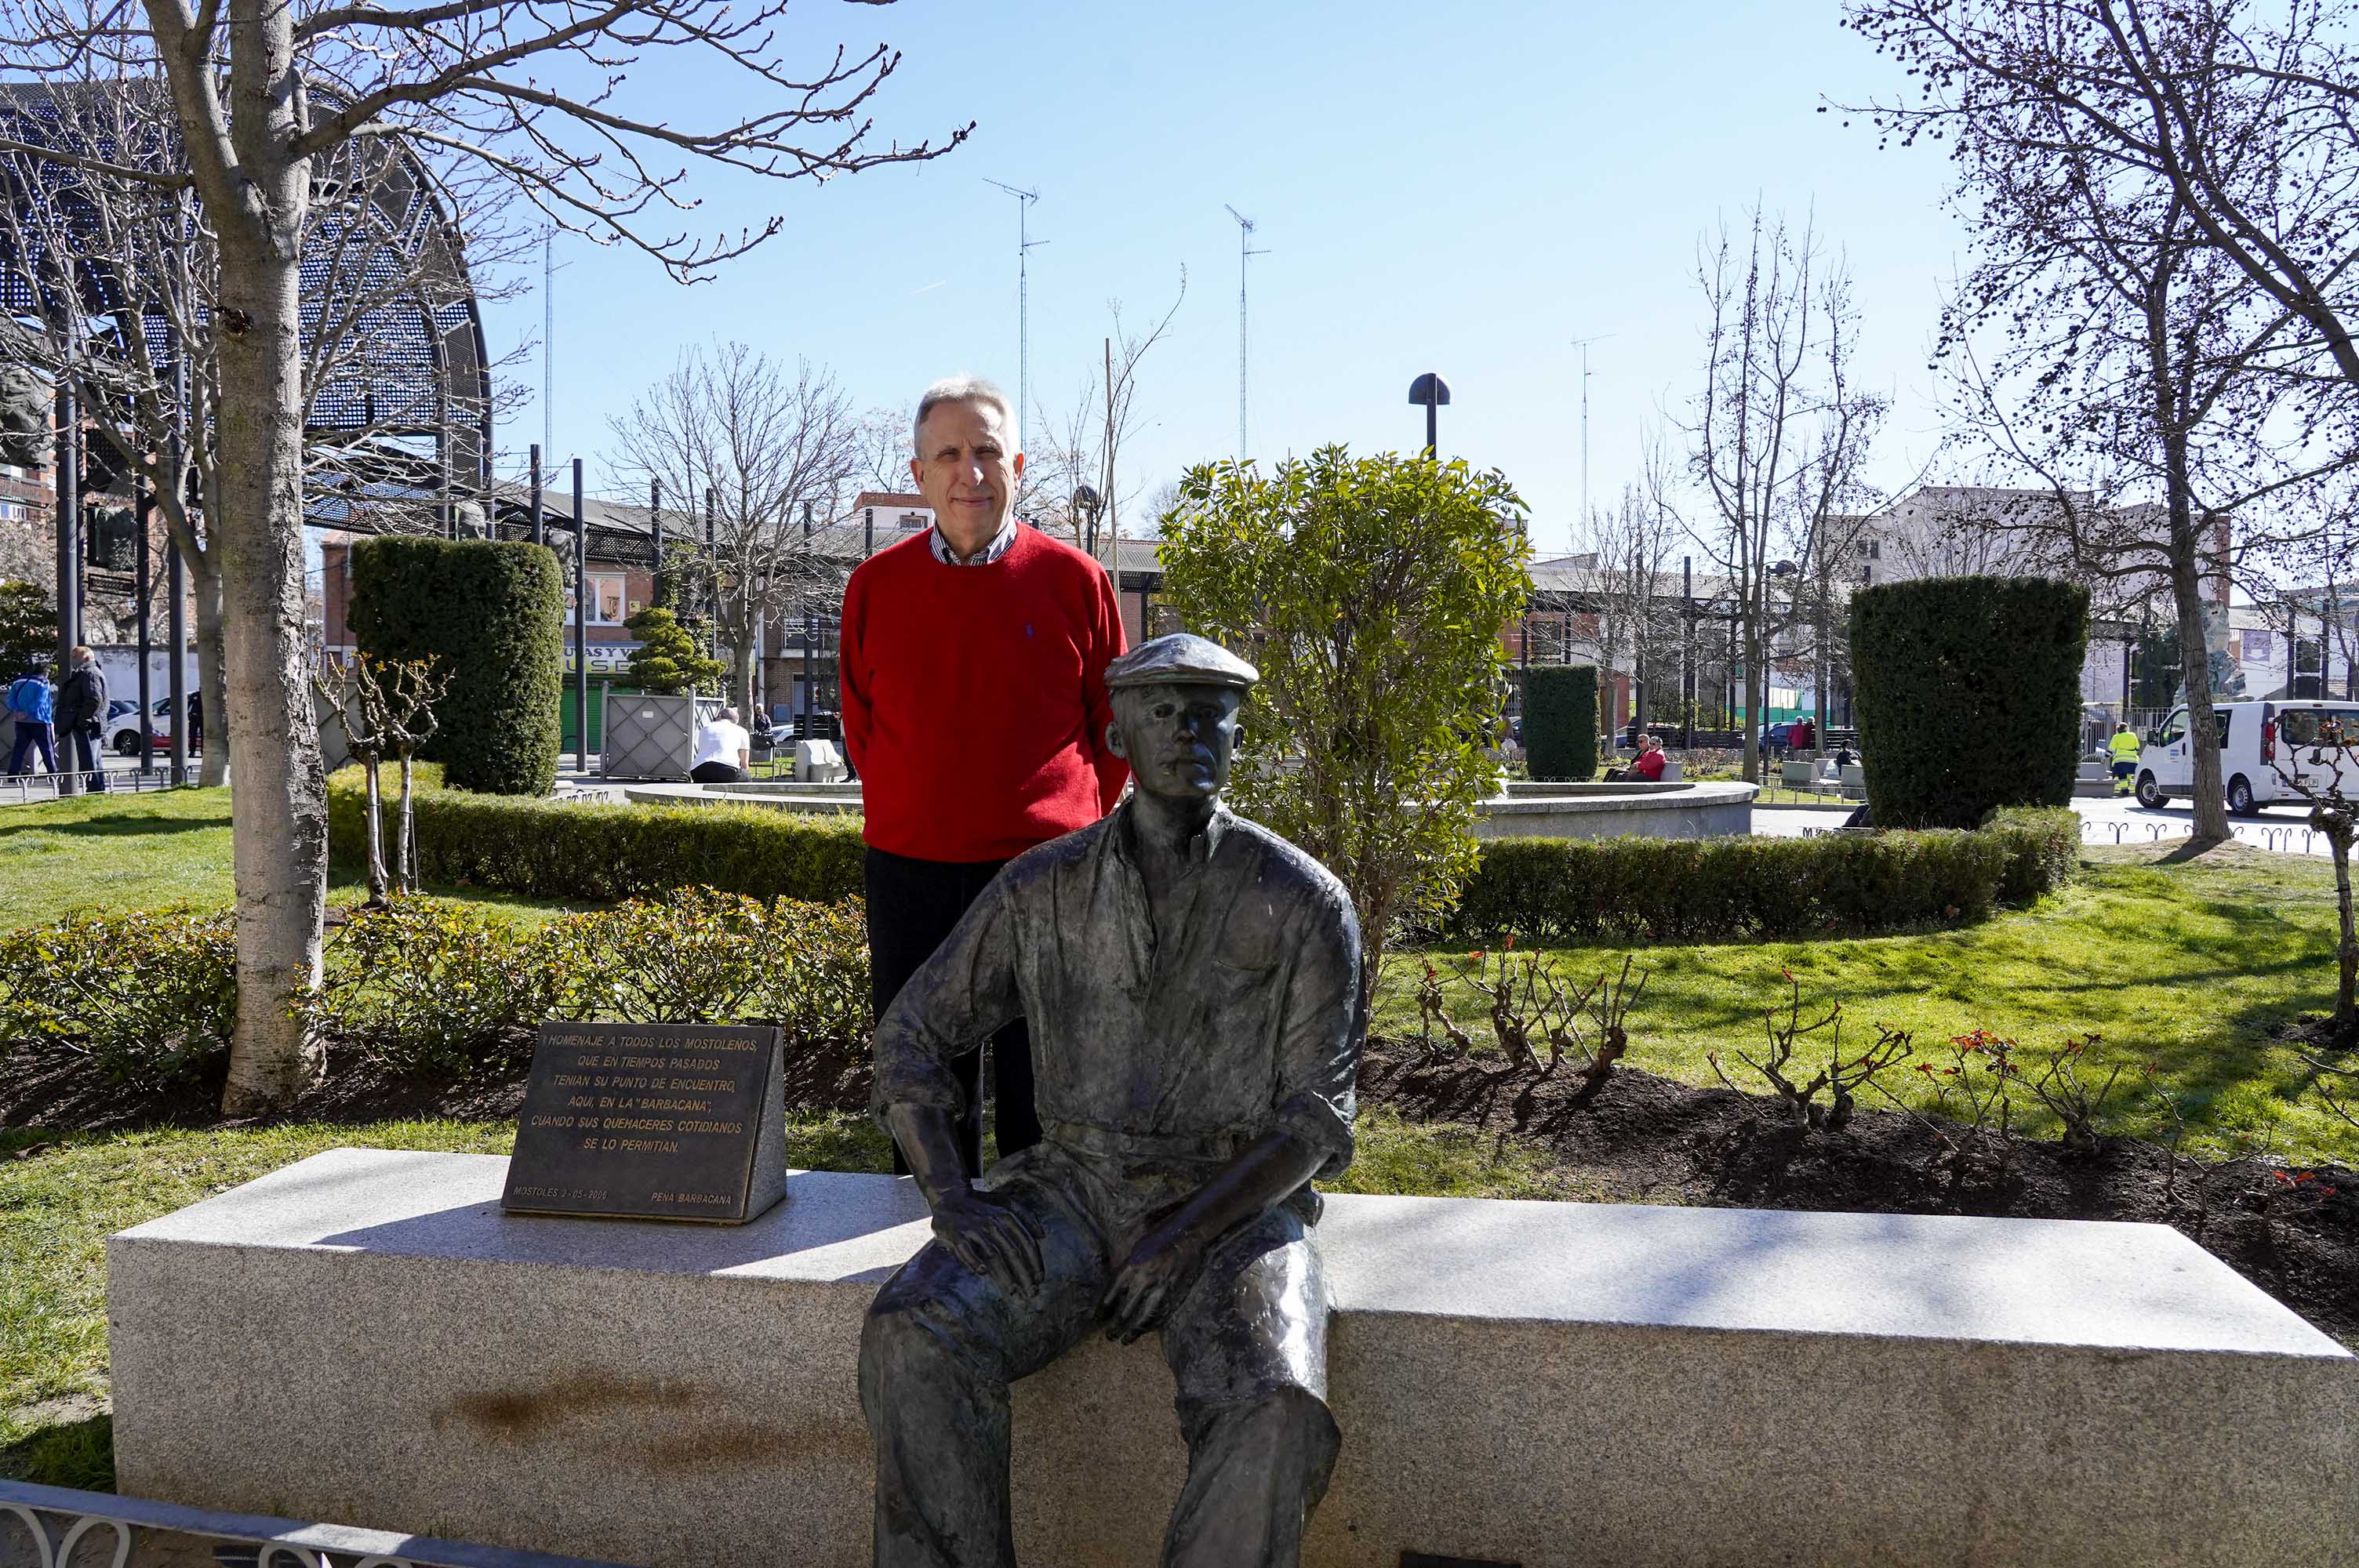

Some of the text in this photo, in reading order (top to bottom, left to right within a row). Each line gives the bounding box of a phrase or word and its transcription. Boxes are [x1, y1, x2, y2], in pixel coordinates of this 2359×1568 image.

[605, 648, 616, 657] Y
[548, 1034, 604, 1047] HOMENAJE
[608, 1036, 616, 1047] A
[620, 1036, 656, 1048] TODOS
[658, 1036, 681, 1049] LOS
[577, 1055, 722, 1071] QUE EN TIEMPOS PASADOS
[594, 1076, 609, 1087] SU
[612, 1077, 648, 1089] PUNTO
[650, 1077, 667, 1089] DE
[670, 1078, 736, 1094] ENCUENTRO,
[599, 1097, 615, 1109] EN
[618, 1098, 634, 1109] LA
[531, 1115, 743, 1134] CUANDO SUS QUEHACERES COTIDIANOS
[583, 1138, 599, 1149] SE
[602, 1138, 617, 1150] LO
[678, 1192, 732, 1206] BARBACANA
